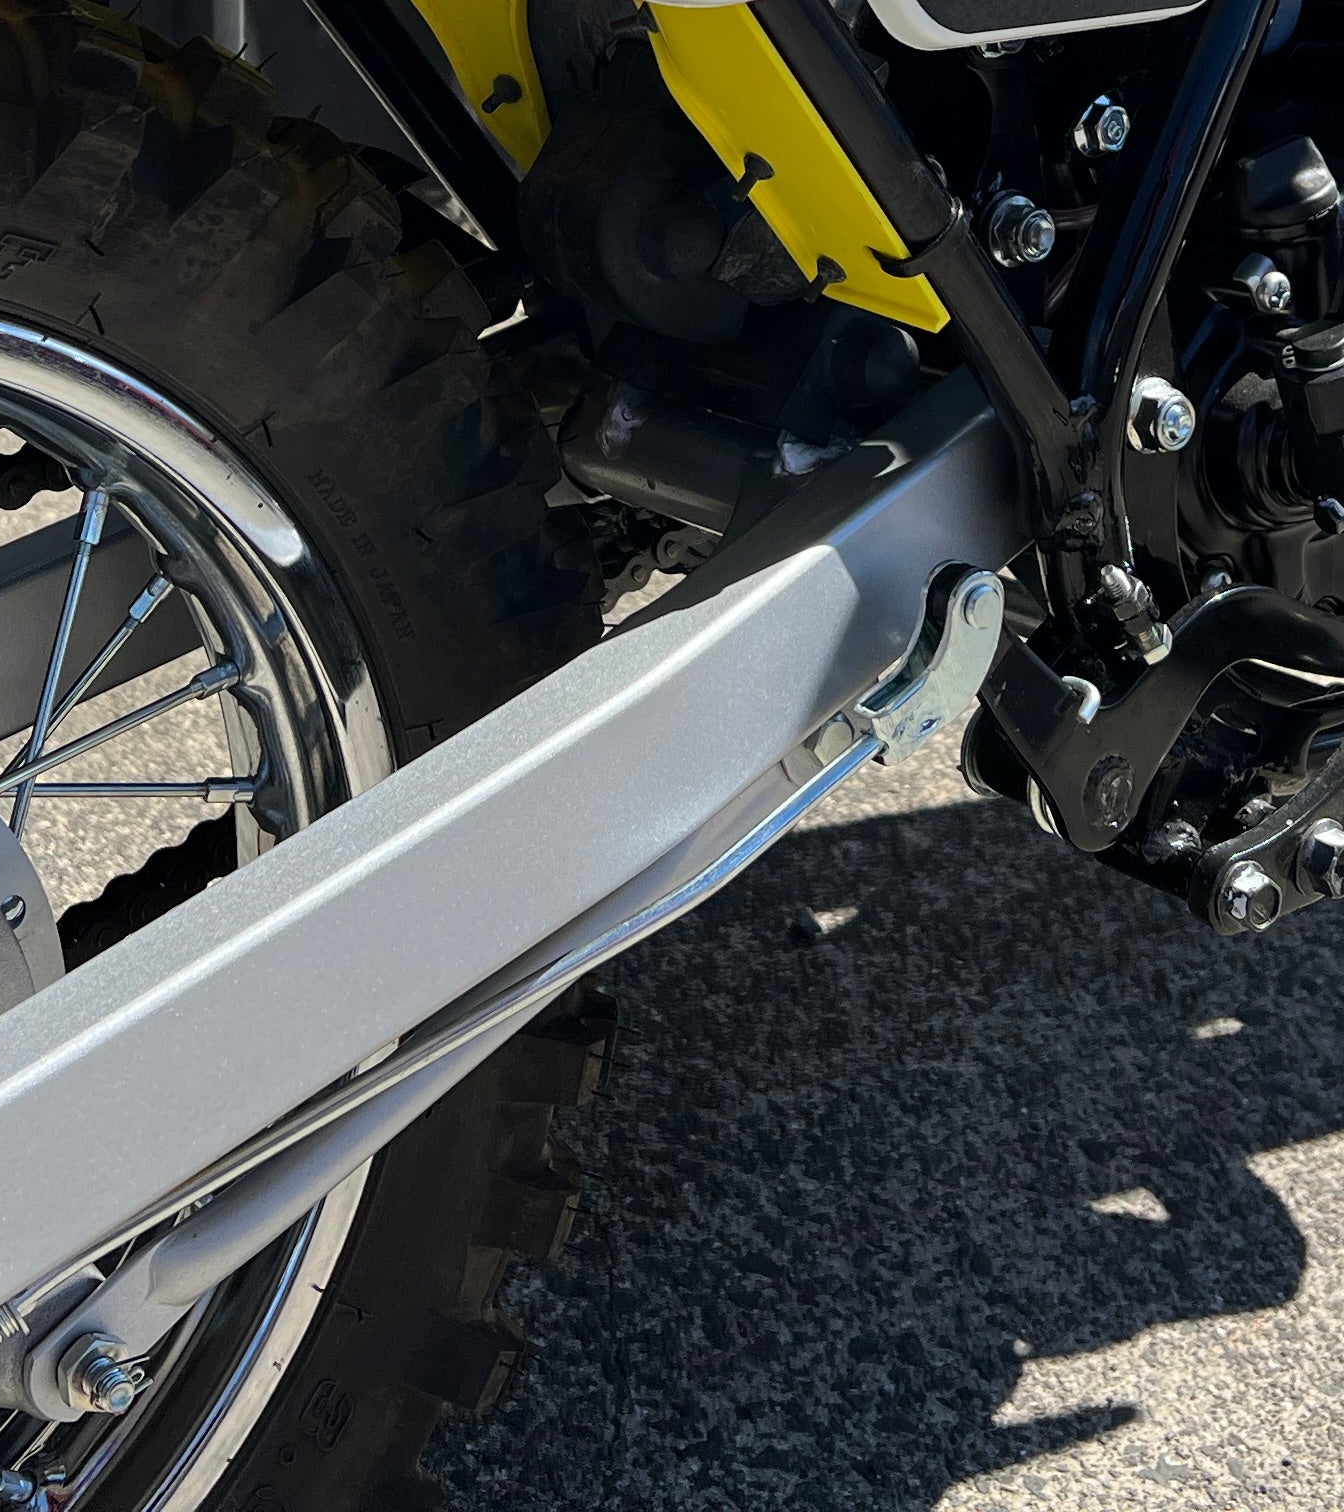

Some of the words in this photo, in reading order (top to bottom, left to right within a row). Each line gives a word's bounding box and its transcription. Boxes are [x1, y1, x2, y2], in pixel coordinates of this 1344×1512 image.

[307, 467, 360, 530] MADE
[350, 530, 378, 558] IN
[368, 565, 418, 641] JAPAN
